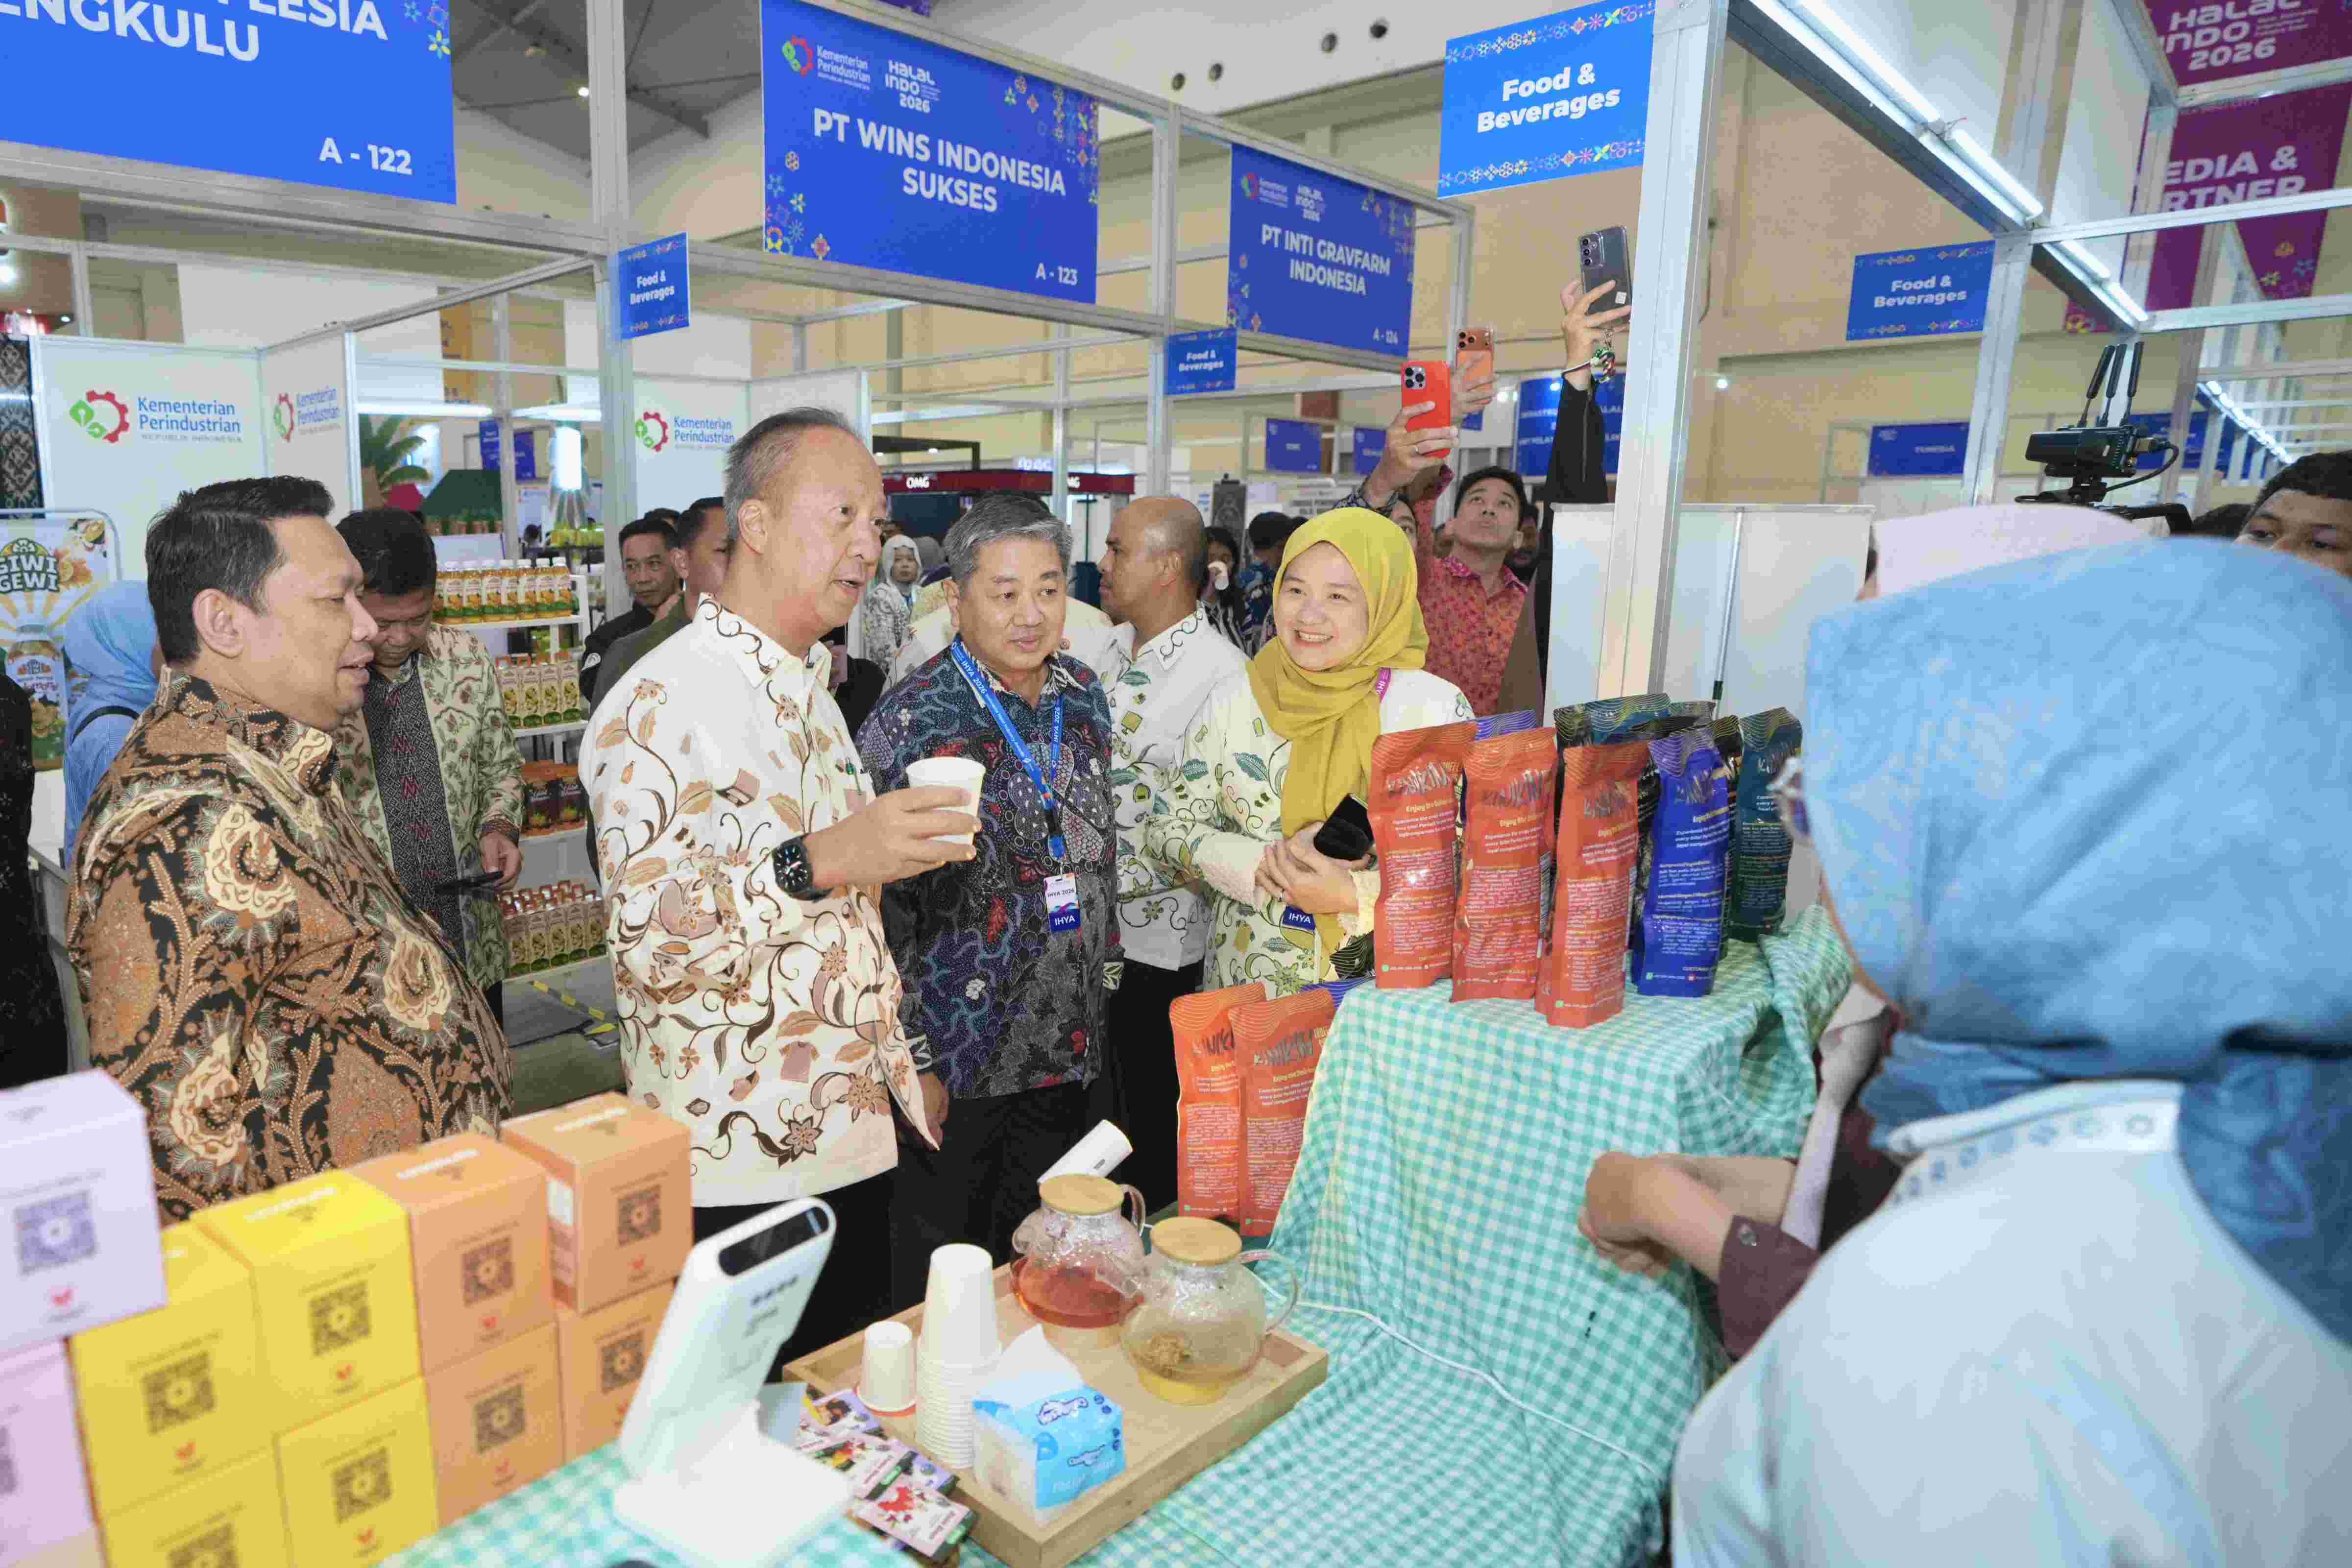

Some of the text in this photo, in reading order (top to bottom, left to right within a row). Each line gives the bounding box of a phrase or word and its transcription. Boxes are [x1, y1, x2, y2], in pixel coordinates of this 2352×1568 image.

[2188, 37, 2276, 71] 2026
[1502, 63, 1595, 101] Food &
[899, 93, 930, 114] 2026
[1477, 88, 1621, 133] Beverages
[319, 136, 343, 164] A
[367, 144, 412, 175] 122
[814, 108, 1066, 196] PT WINS INDONESIA
[2164, 145, 2298, 184] EDIA &
[902, 167, 997, 212] SUKSES
[2161, 175, 2306, 213] RTNER
[1261, 224, 1391, 277] PT INTI GRAVFARM
[636, 269, 667, 289] Food &
[1035, 263, 1047, 280] A
[1058, 265, 1078, 286] 123
[1290, 258, 1366, 295] INDONESIA
[1891, 274, 1952, 292] Food &
[630, 285, 675, 305] Beverages
[1874, 290, 1967, 308] Beverages
[1372, 326, 1380, 341] A
[1187, 350, 1209, 361] Food
[1179, 360, 1224, 372] Beverages
[138, 396, 235, 415] Kementerian
[139, 415, 241, 433] Perindustrian
[674, 415, 733, 431] Kementerian
[675, 430, 734, 443] Perindustrian
[1055, 915, 1075, 925] IHYA
[1289, 913, 1311, 923] IHYA
